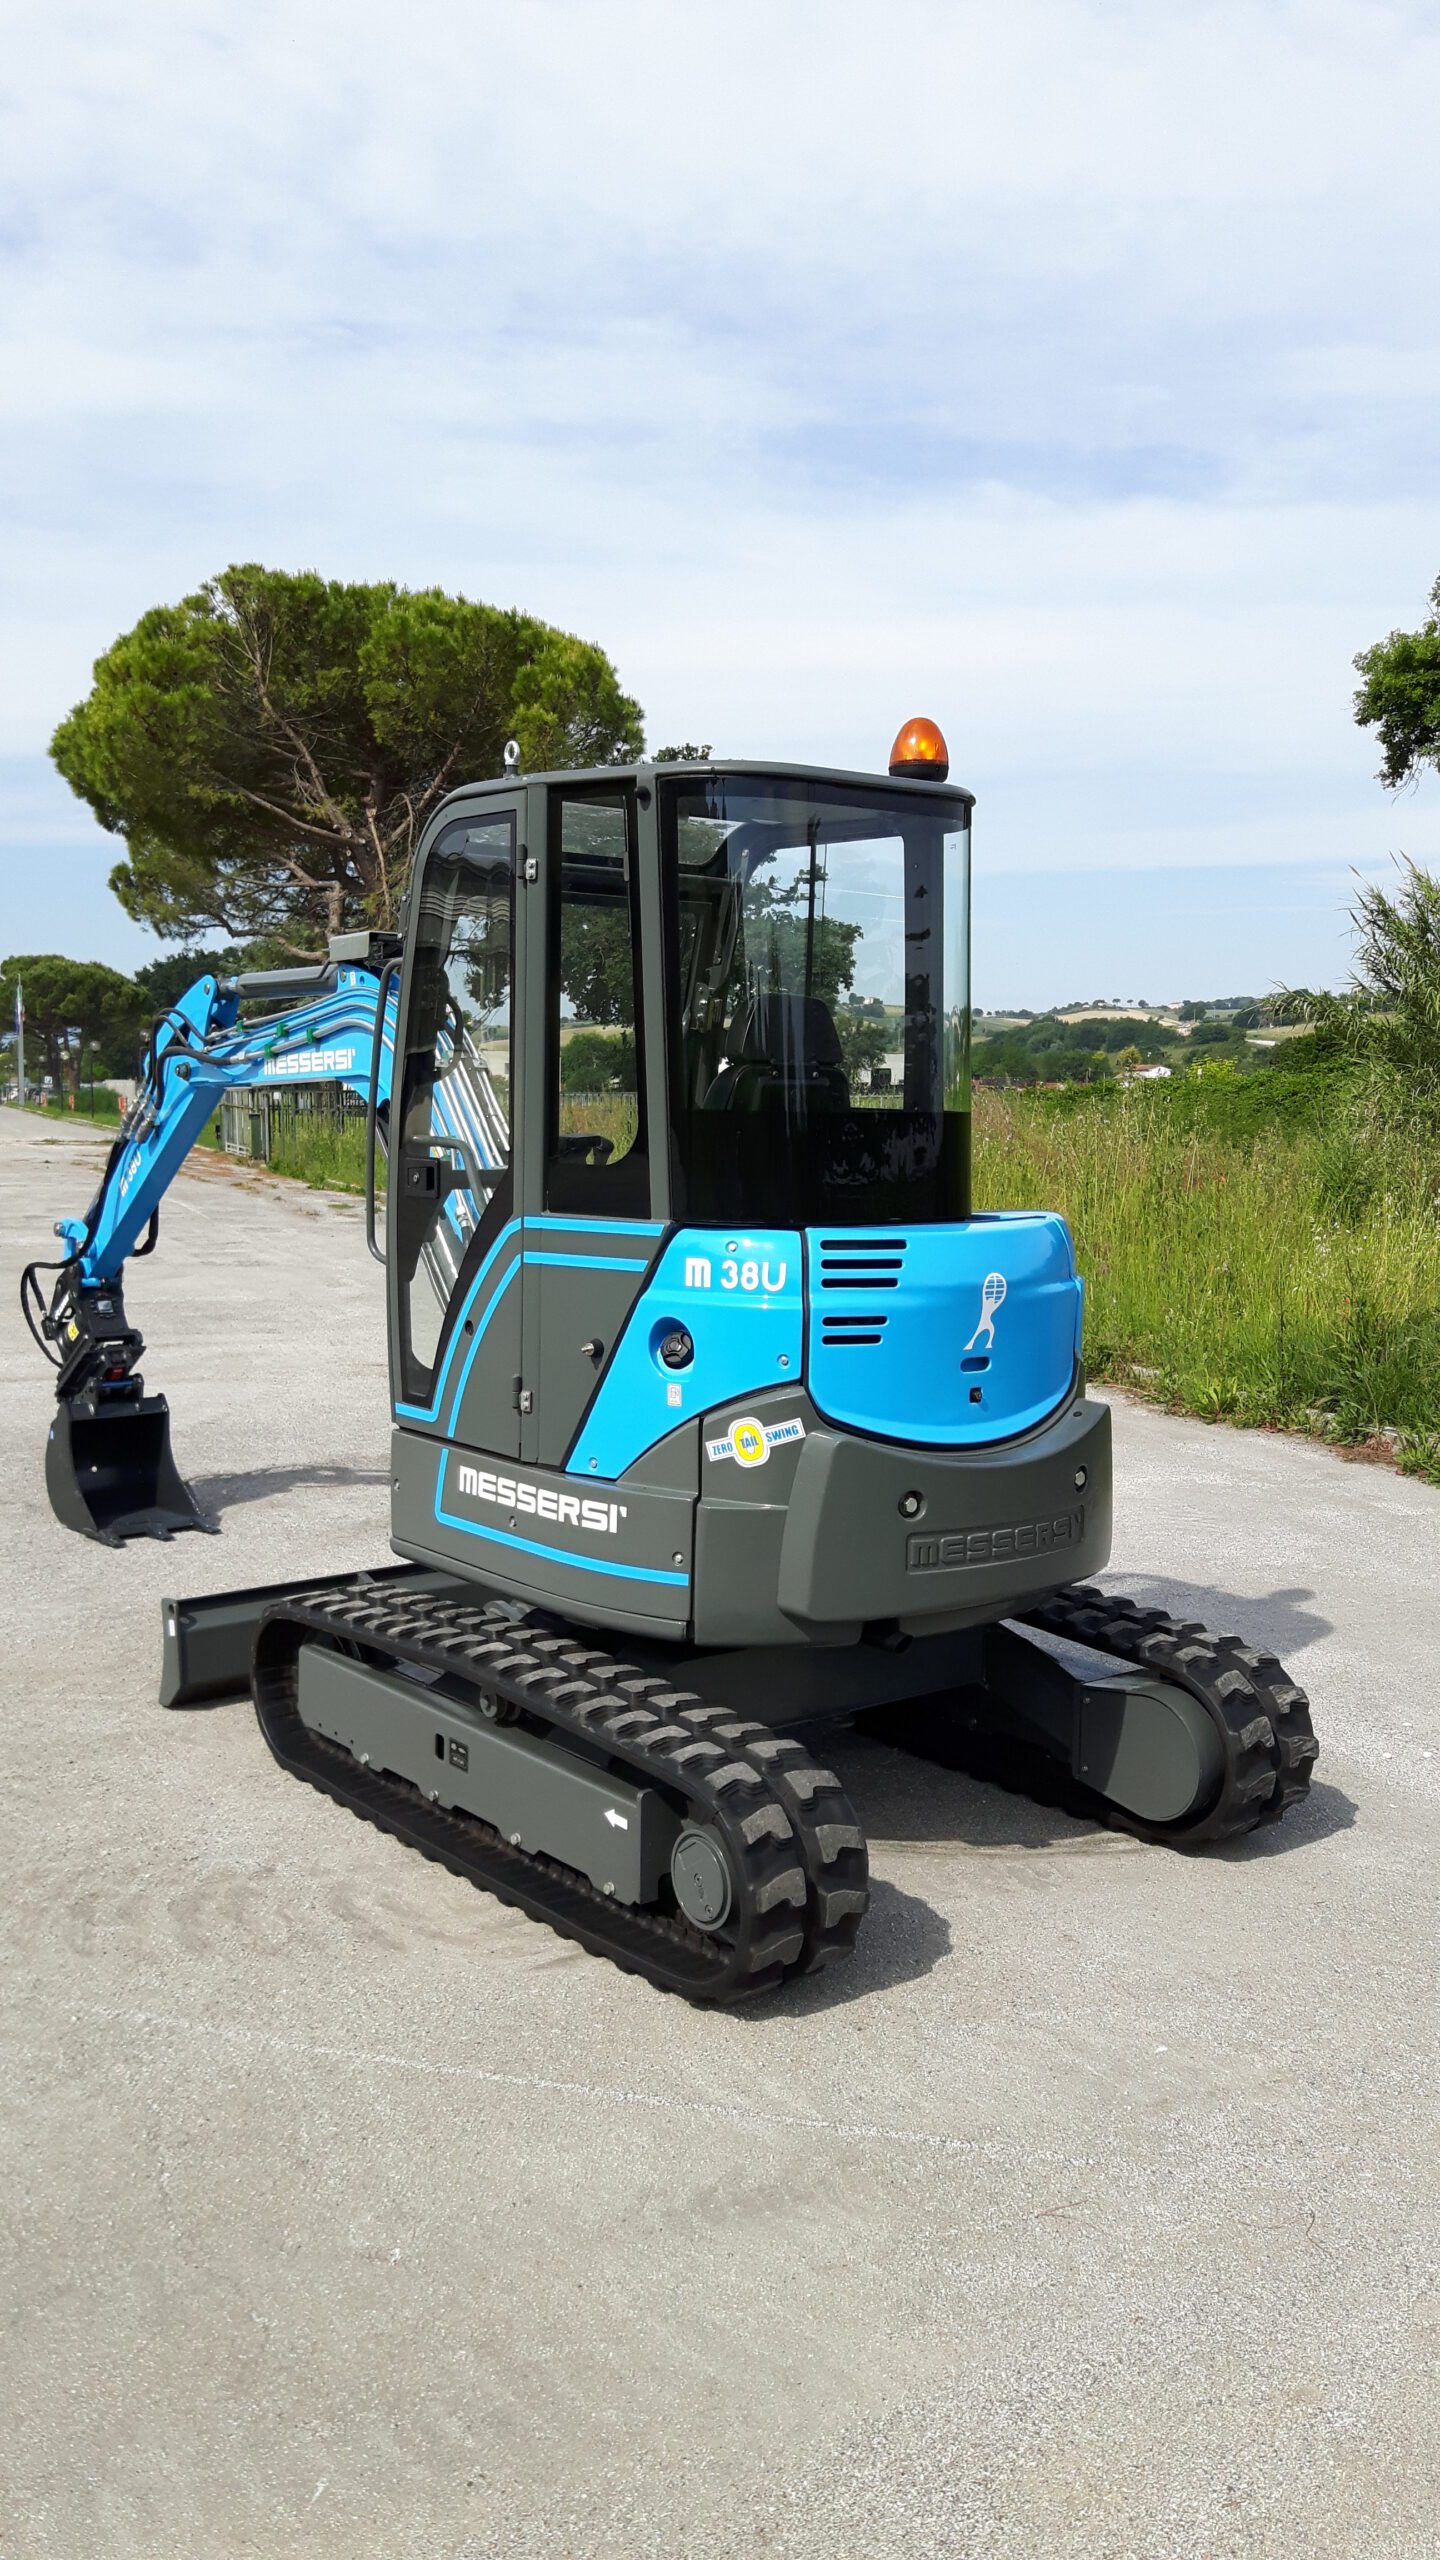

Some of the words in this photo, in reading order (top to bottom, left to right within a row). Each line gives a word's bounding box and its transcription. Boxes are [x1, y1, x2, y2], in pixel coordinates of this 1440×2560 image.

[720, 1259, 787, 1292] 38U
[712, 1442, 734, 1456] ZERO
[739, 1435, 760, 1449] TAIL
[765, 1424, 799, 1443] SWING
